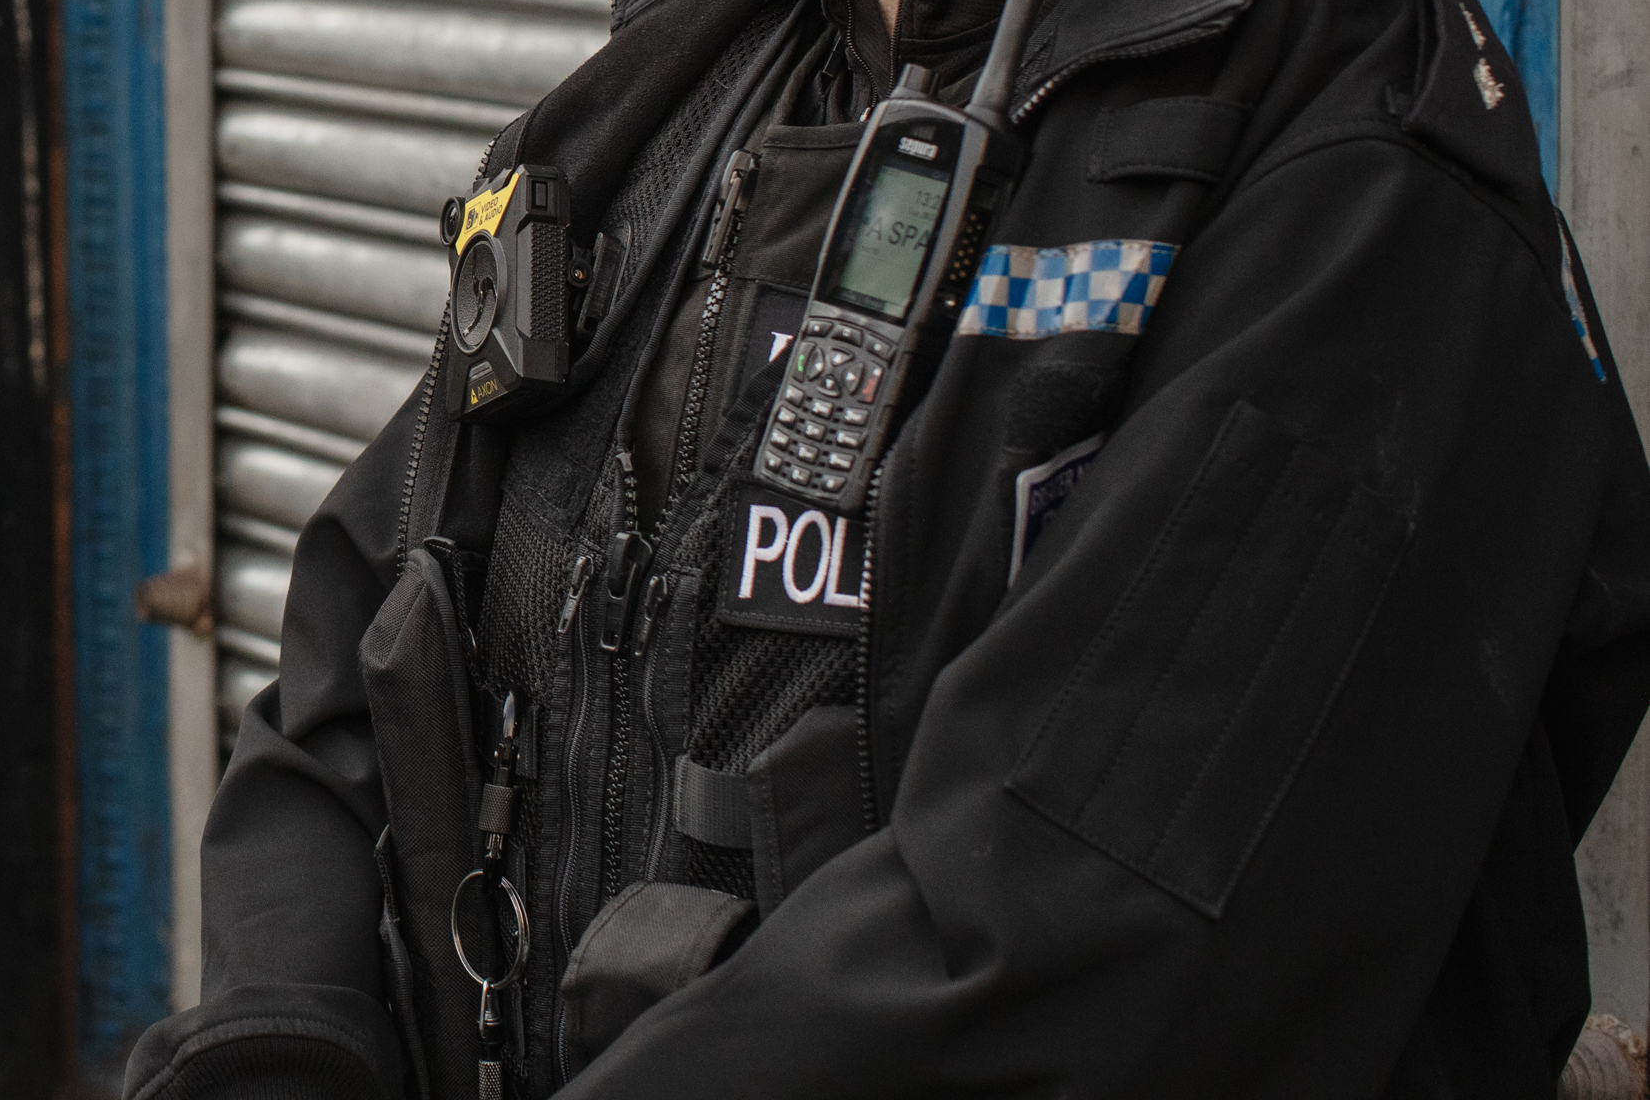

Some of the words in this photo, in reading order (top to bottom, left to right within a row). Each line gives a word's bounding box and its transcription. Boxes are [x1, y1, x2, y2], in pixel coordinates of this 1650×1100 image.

[481, 197, 498, 213] VIDEO
[484, 204, 503, 223] AUDIO
[478, 379, 498, 399] AXON
[738, 505, 868, 608] POL
